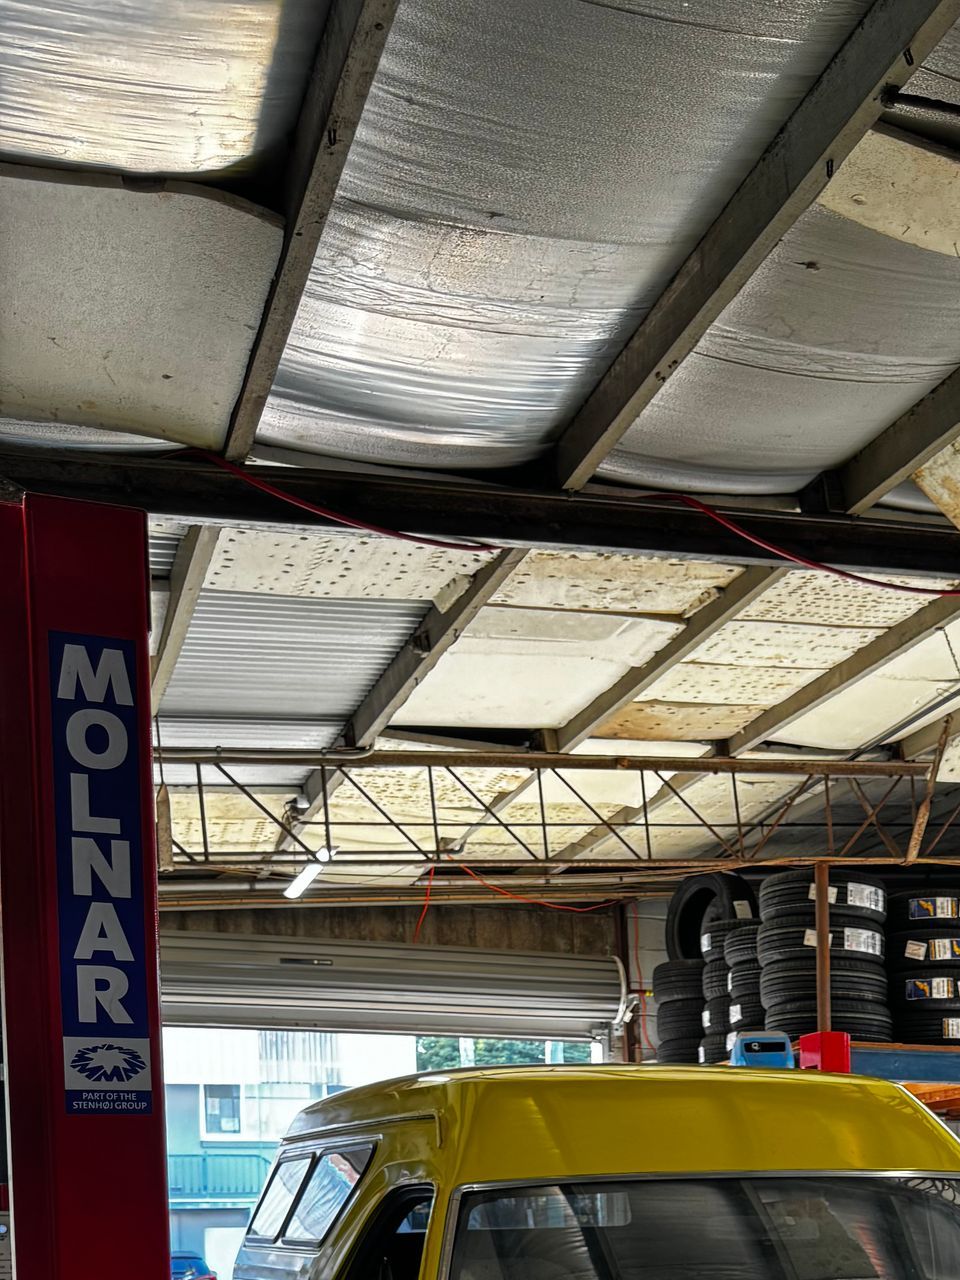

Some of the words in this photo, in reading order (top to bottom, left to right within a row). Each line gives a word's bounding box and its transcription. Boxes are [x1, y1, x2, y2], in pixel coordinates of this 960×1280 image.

[57, 642, 134, 1025] MOLNAR
[82, 1092, 105, 1100] PART
[106, 1092, 118, 1100] OF
[120, 1093, 137, 1101] THE
